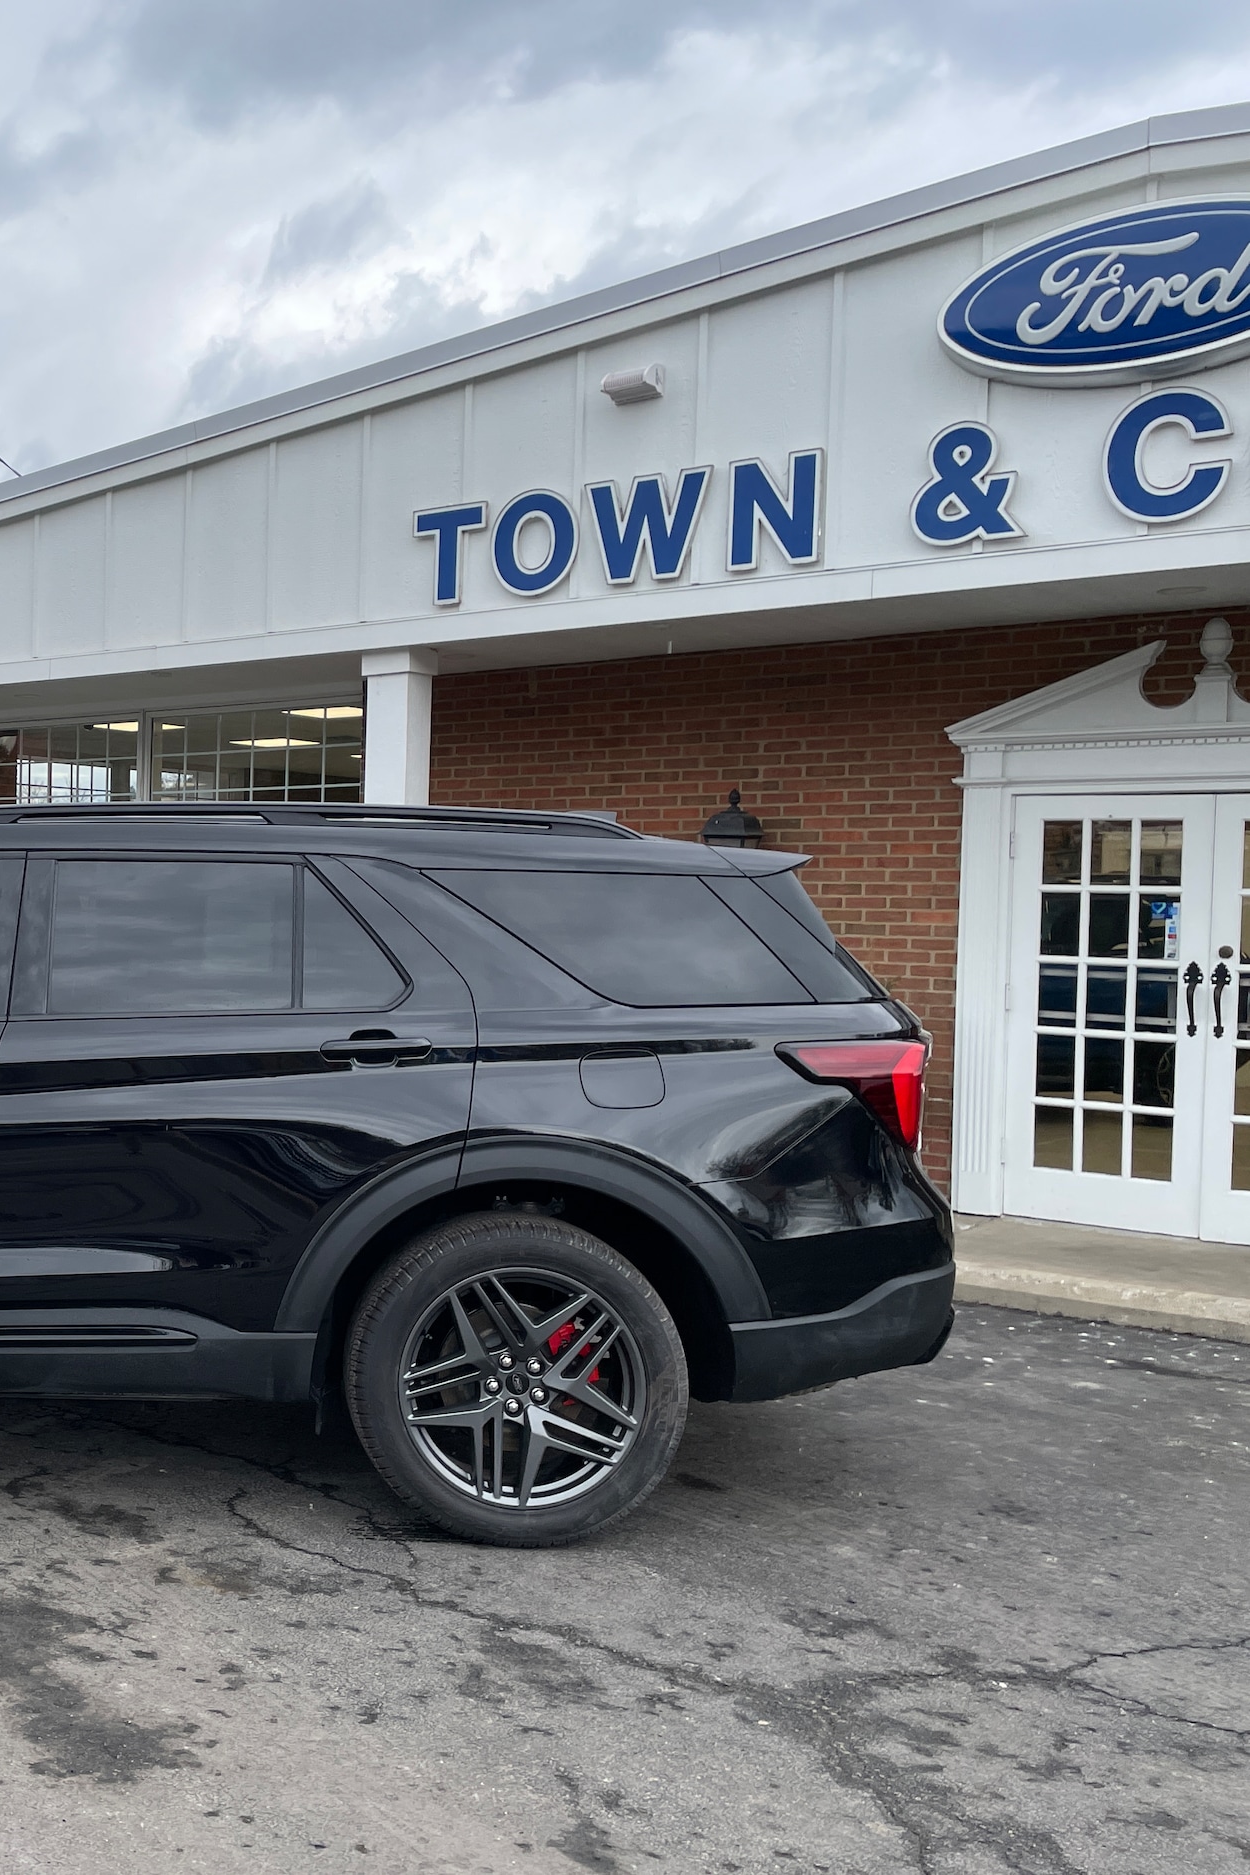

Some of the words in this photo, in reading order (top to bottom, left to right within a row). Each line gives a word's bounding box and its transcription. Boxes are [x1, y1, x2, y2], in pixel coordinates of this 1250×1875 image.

[1015, 231, 1250, 345] Ford
[412, 447, 825, 606] TOWN
[909, 420, 1029, 547] &
[1102, 386, 1234, 524] C
